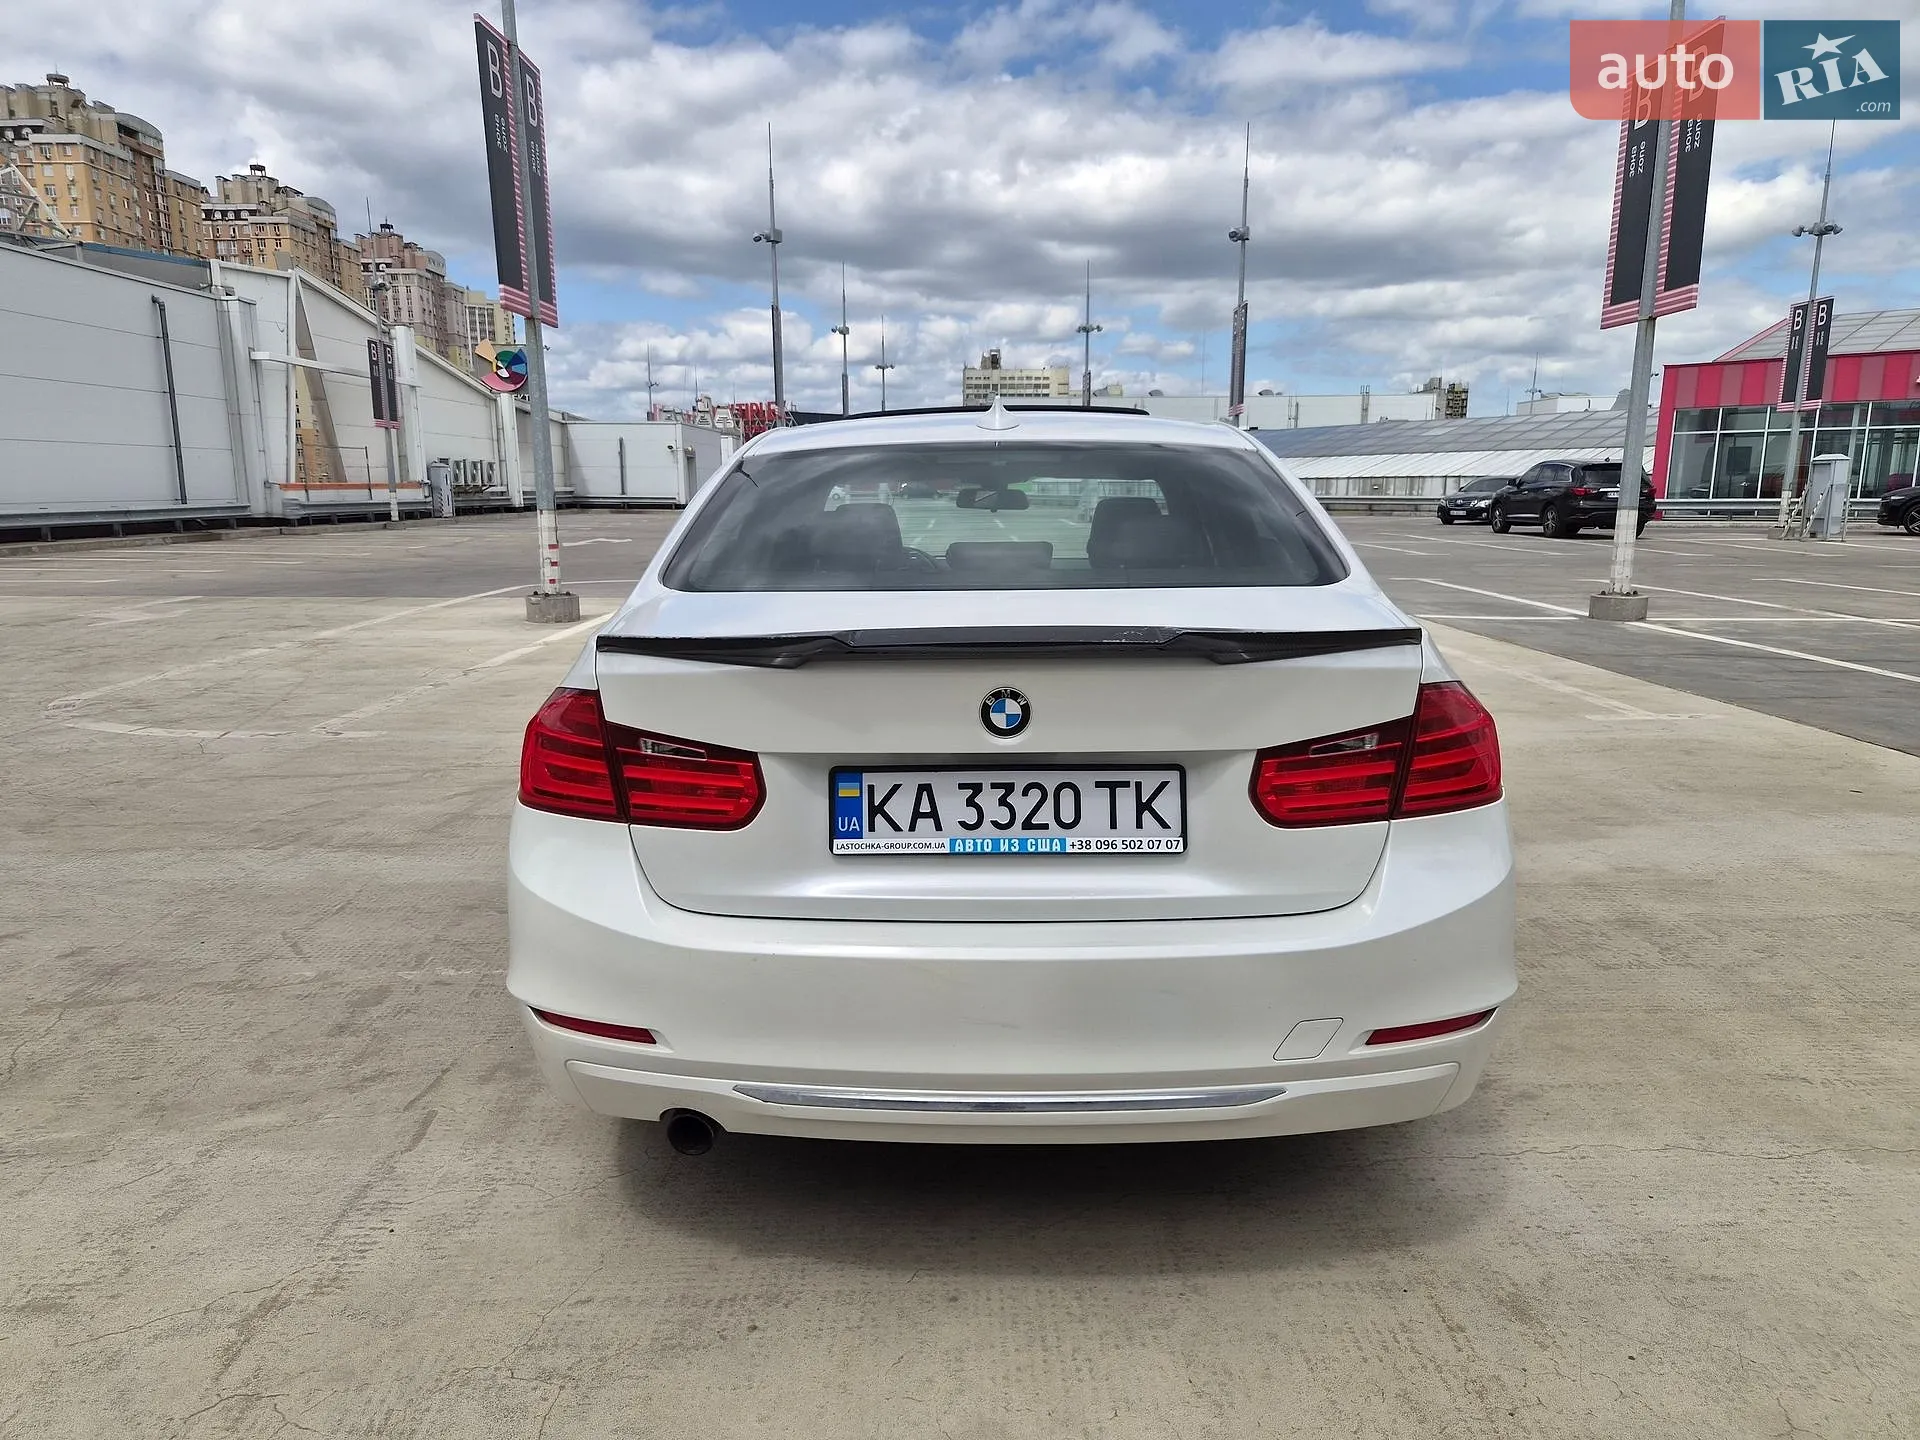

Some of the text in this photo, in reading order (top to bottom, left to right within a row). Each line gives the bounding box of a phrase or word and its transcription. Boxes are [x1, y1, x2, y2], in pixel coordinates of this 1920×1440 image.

[487, 39, 503, 99] B
[525, 73, 538, 128] B
[1793, 309, 1803, 331] B
[1818, 303, 1828, 326] B
[370, 343, 378, 361] B
[386, 347, 393, 364] B
[867, 780, 1172, 833] KA 3320 TK
[838, 816, 861, 832] UA
[836, 842, 947, 851] LASTOCHKA-GROUP.COM.UA
[955, 838, 1061, 852] АВТО ИЗ США
[1069, 839, 1180, 851] +38 096 502 07 07
